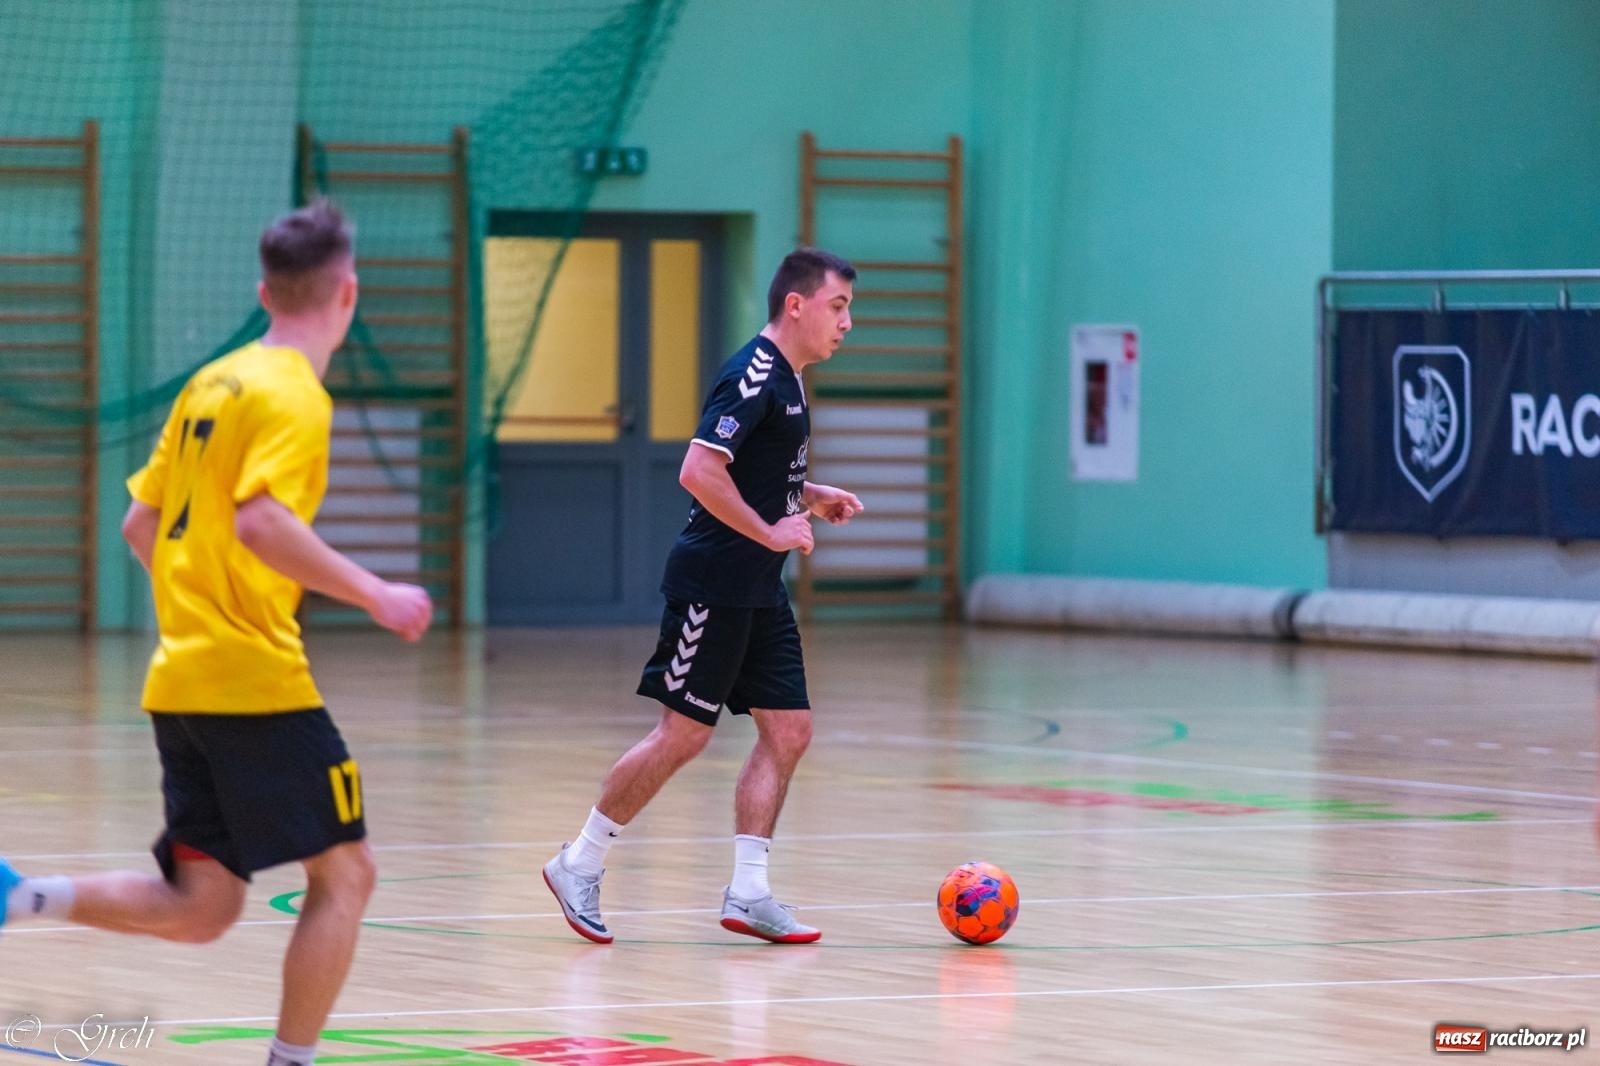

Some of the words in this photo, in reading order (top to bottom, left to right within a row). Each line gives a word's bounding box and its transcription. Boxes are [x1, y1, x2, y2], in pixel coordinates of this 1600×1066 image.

[787, 403, 802, 415] hul
[1510, 393, 1600, 458] RAC
[685, 691, 720, 712] hul
[329, 760, 360, 823] 17
